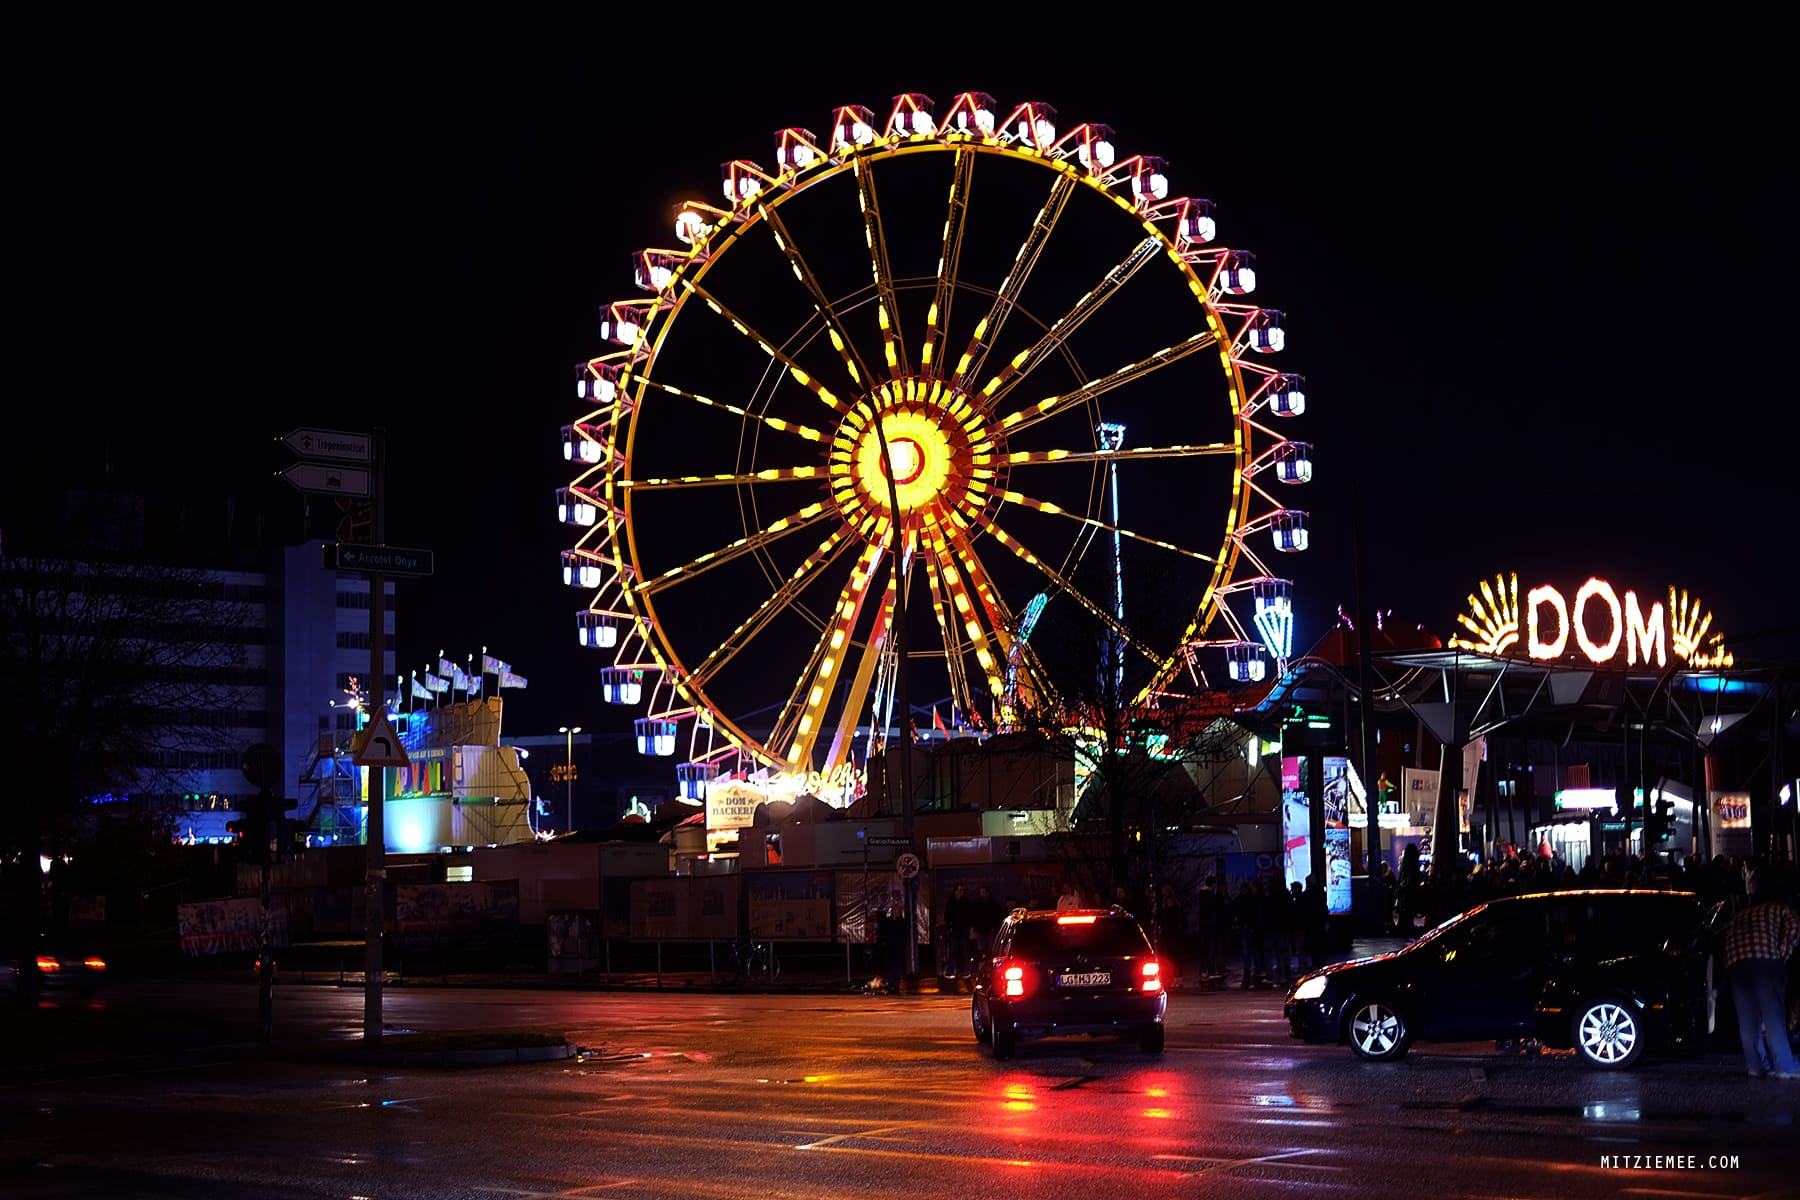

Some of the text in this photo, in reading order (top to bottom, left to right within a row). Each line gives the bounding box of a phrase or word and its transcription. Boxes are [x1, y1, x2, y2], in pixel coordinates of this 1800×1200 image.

[317, 439, 365, 454] Tropeninstitut
[358, 552, 417, 568] Arcotel Onyx
[1527, 576, 1667, 668] DOM
[725, 797, 746, 806] DOM
[1062, 975, 1073, 985] LG
[1092, 974, 1109, 984] 223
